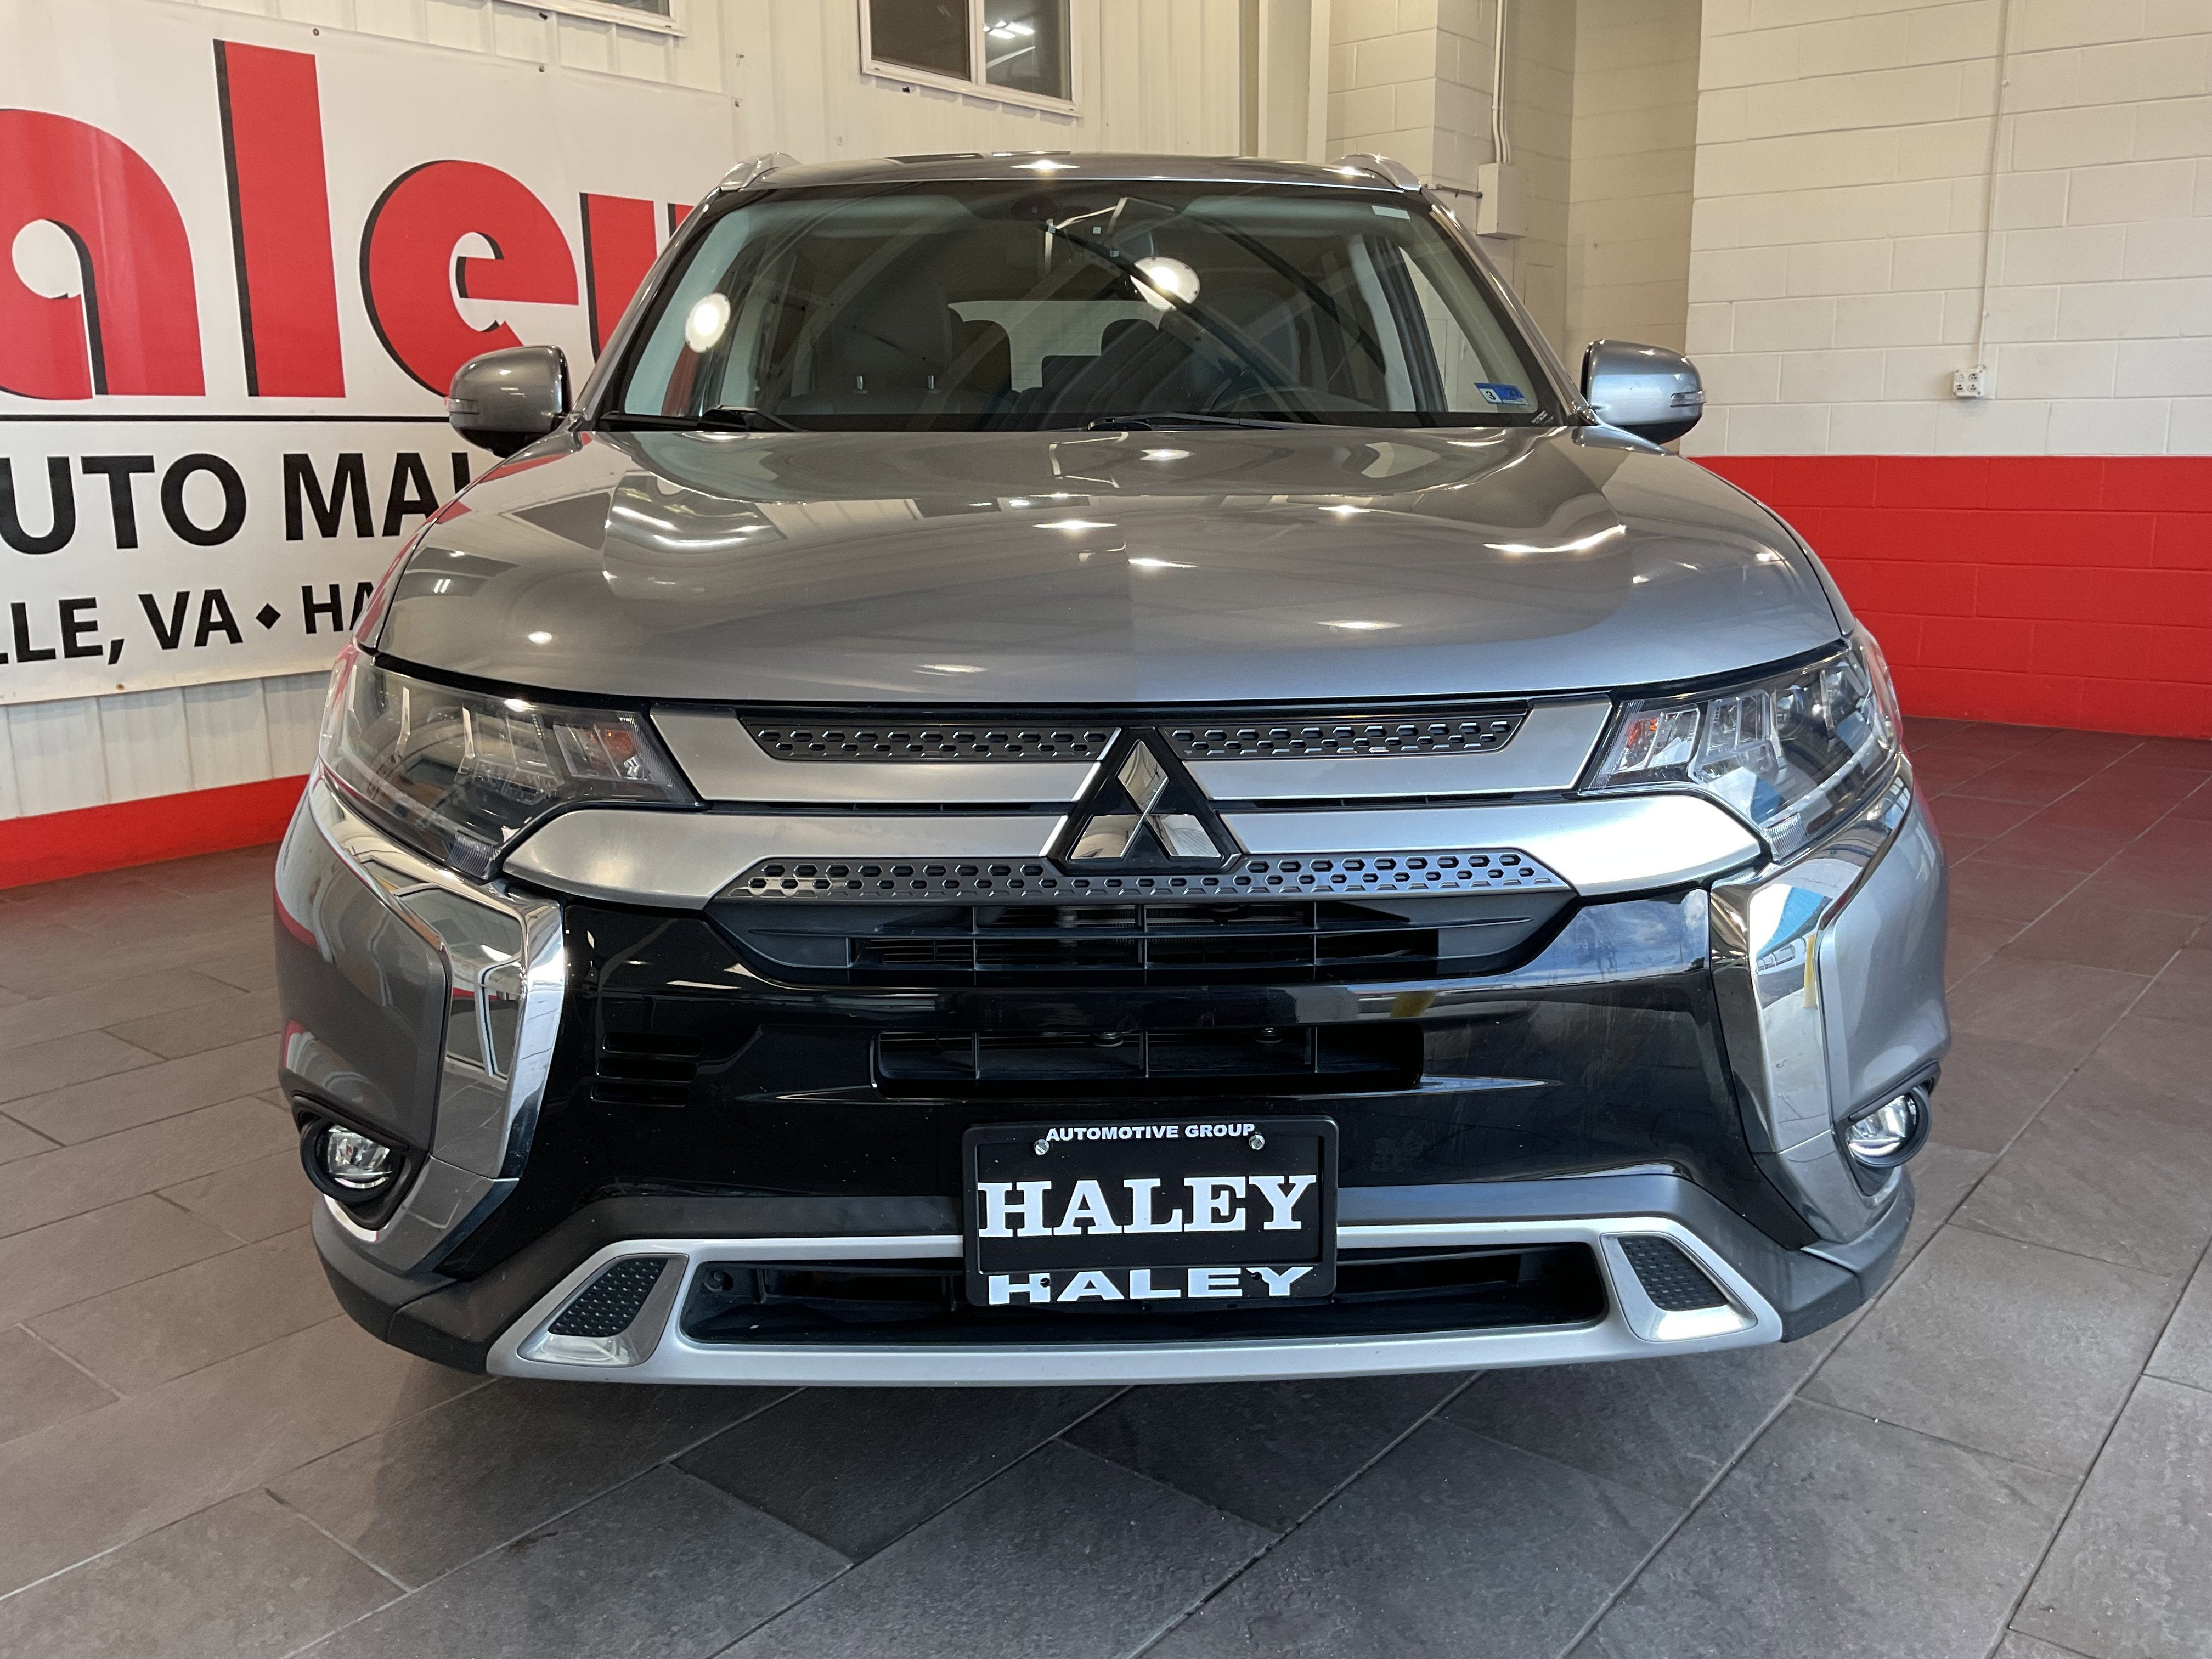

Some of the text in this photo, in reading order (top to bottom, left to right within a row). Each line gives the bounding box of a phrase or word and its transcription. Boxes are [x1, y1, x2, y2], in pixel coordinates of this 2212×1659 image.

[1486, 391, 1496, 400] 3
[0, 453, 247, 555] UTO
[0, 597, 125, 665] LE,
[138, 589, 244, 650] VA
[1045, 1124, 1255, 1141] AUTOMOTIVE GROUP
[977, 1175, 1317, 1237] HALEY
[988, 1266, 1314, 1305] HALEY
